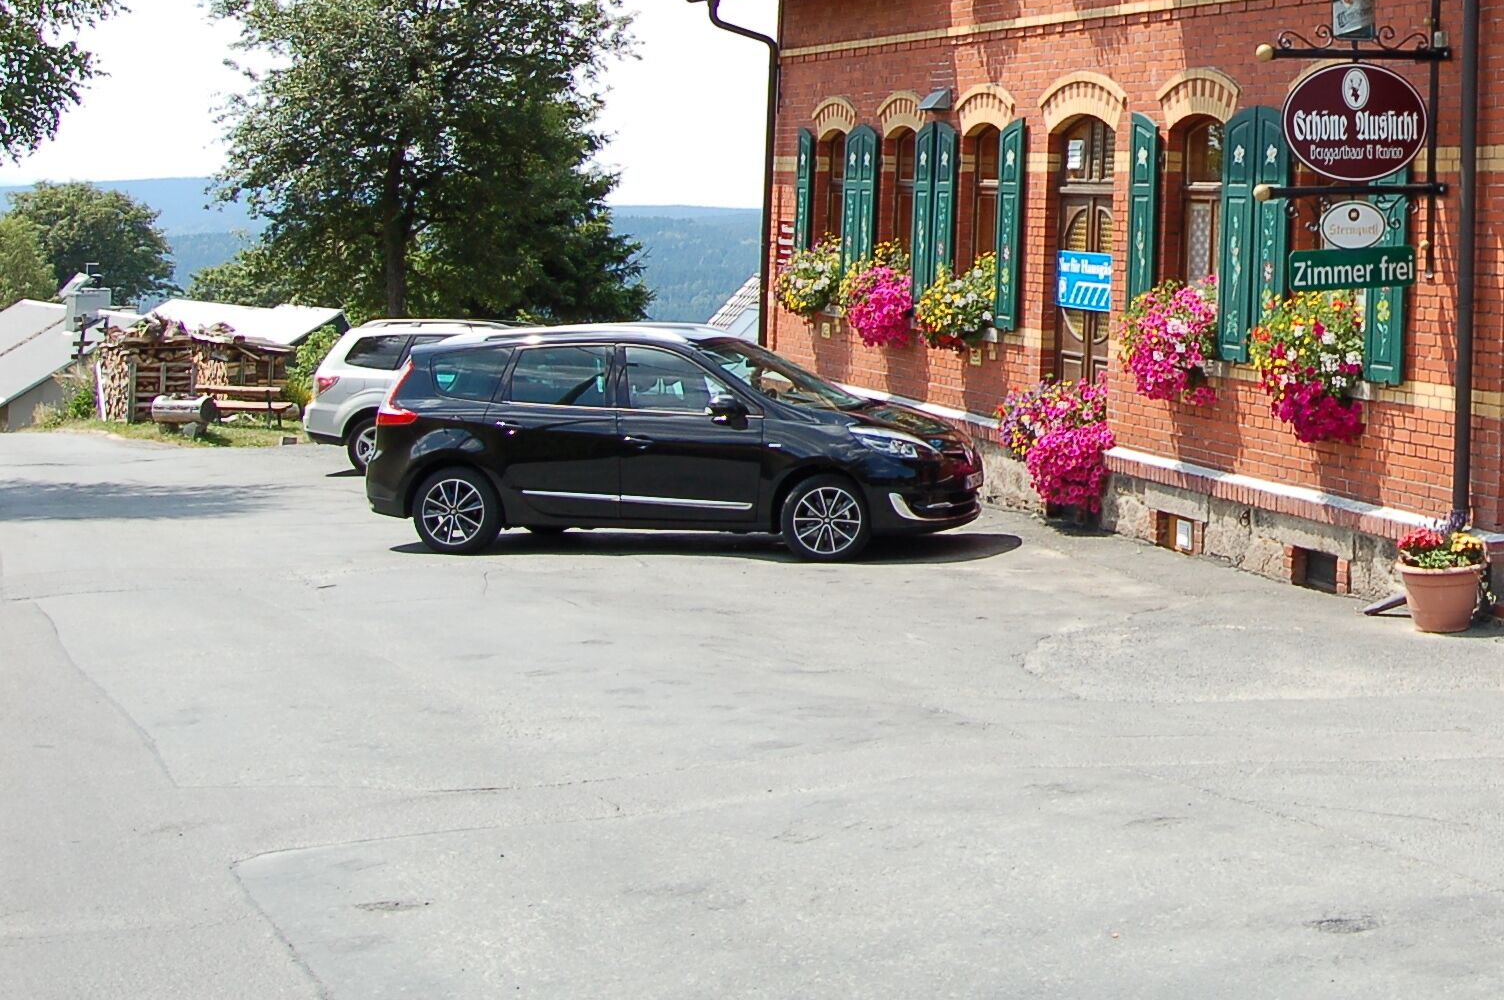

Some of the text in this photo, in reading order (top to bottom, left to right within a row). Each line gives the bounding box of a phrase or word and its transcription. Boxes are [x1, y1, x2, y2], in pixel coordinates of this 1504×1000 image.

[1293, 109, 1418, 142] Schöne Aussicht
[1310, 144, 1364, 165] Berggasthaus
[1375, 144, 1403, 159] Pension
[1293, 255, 1413, 286] Zimmer frei
